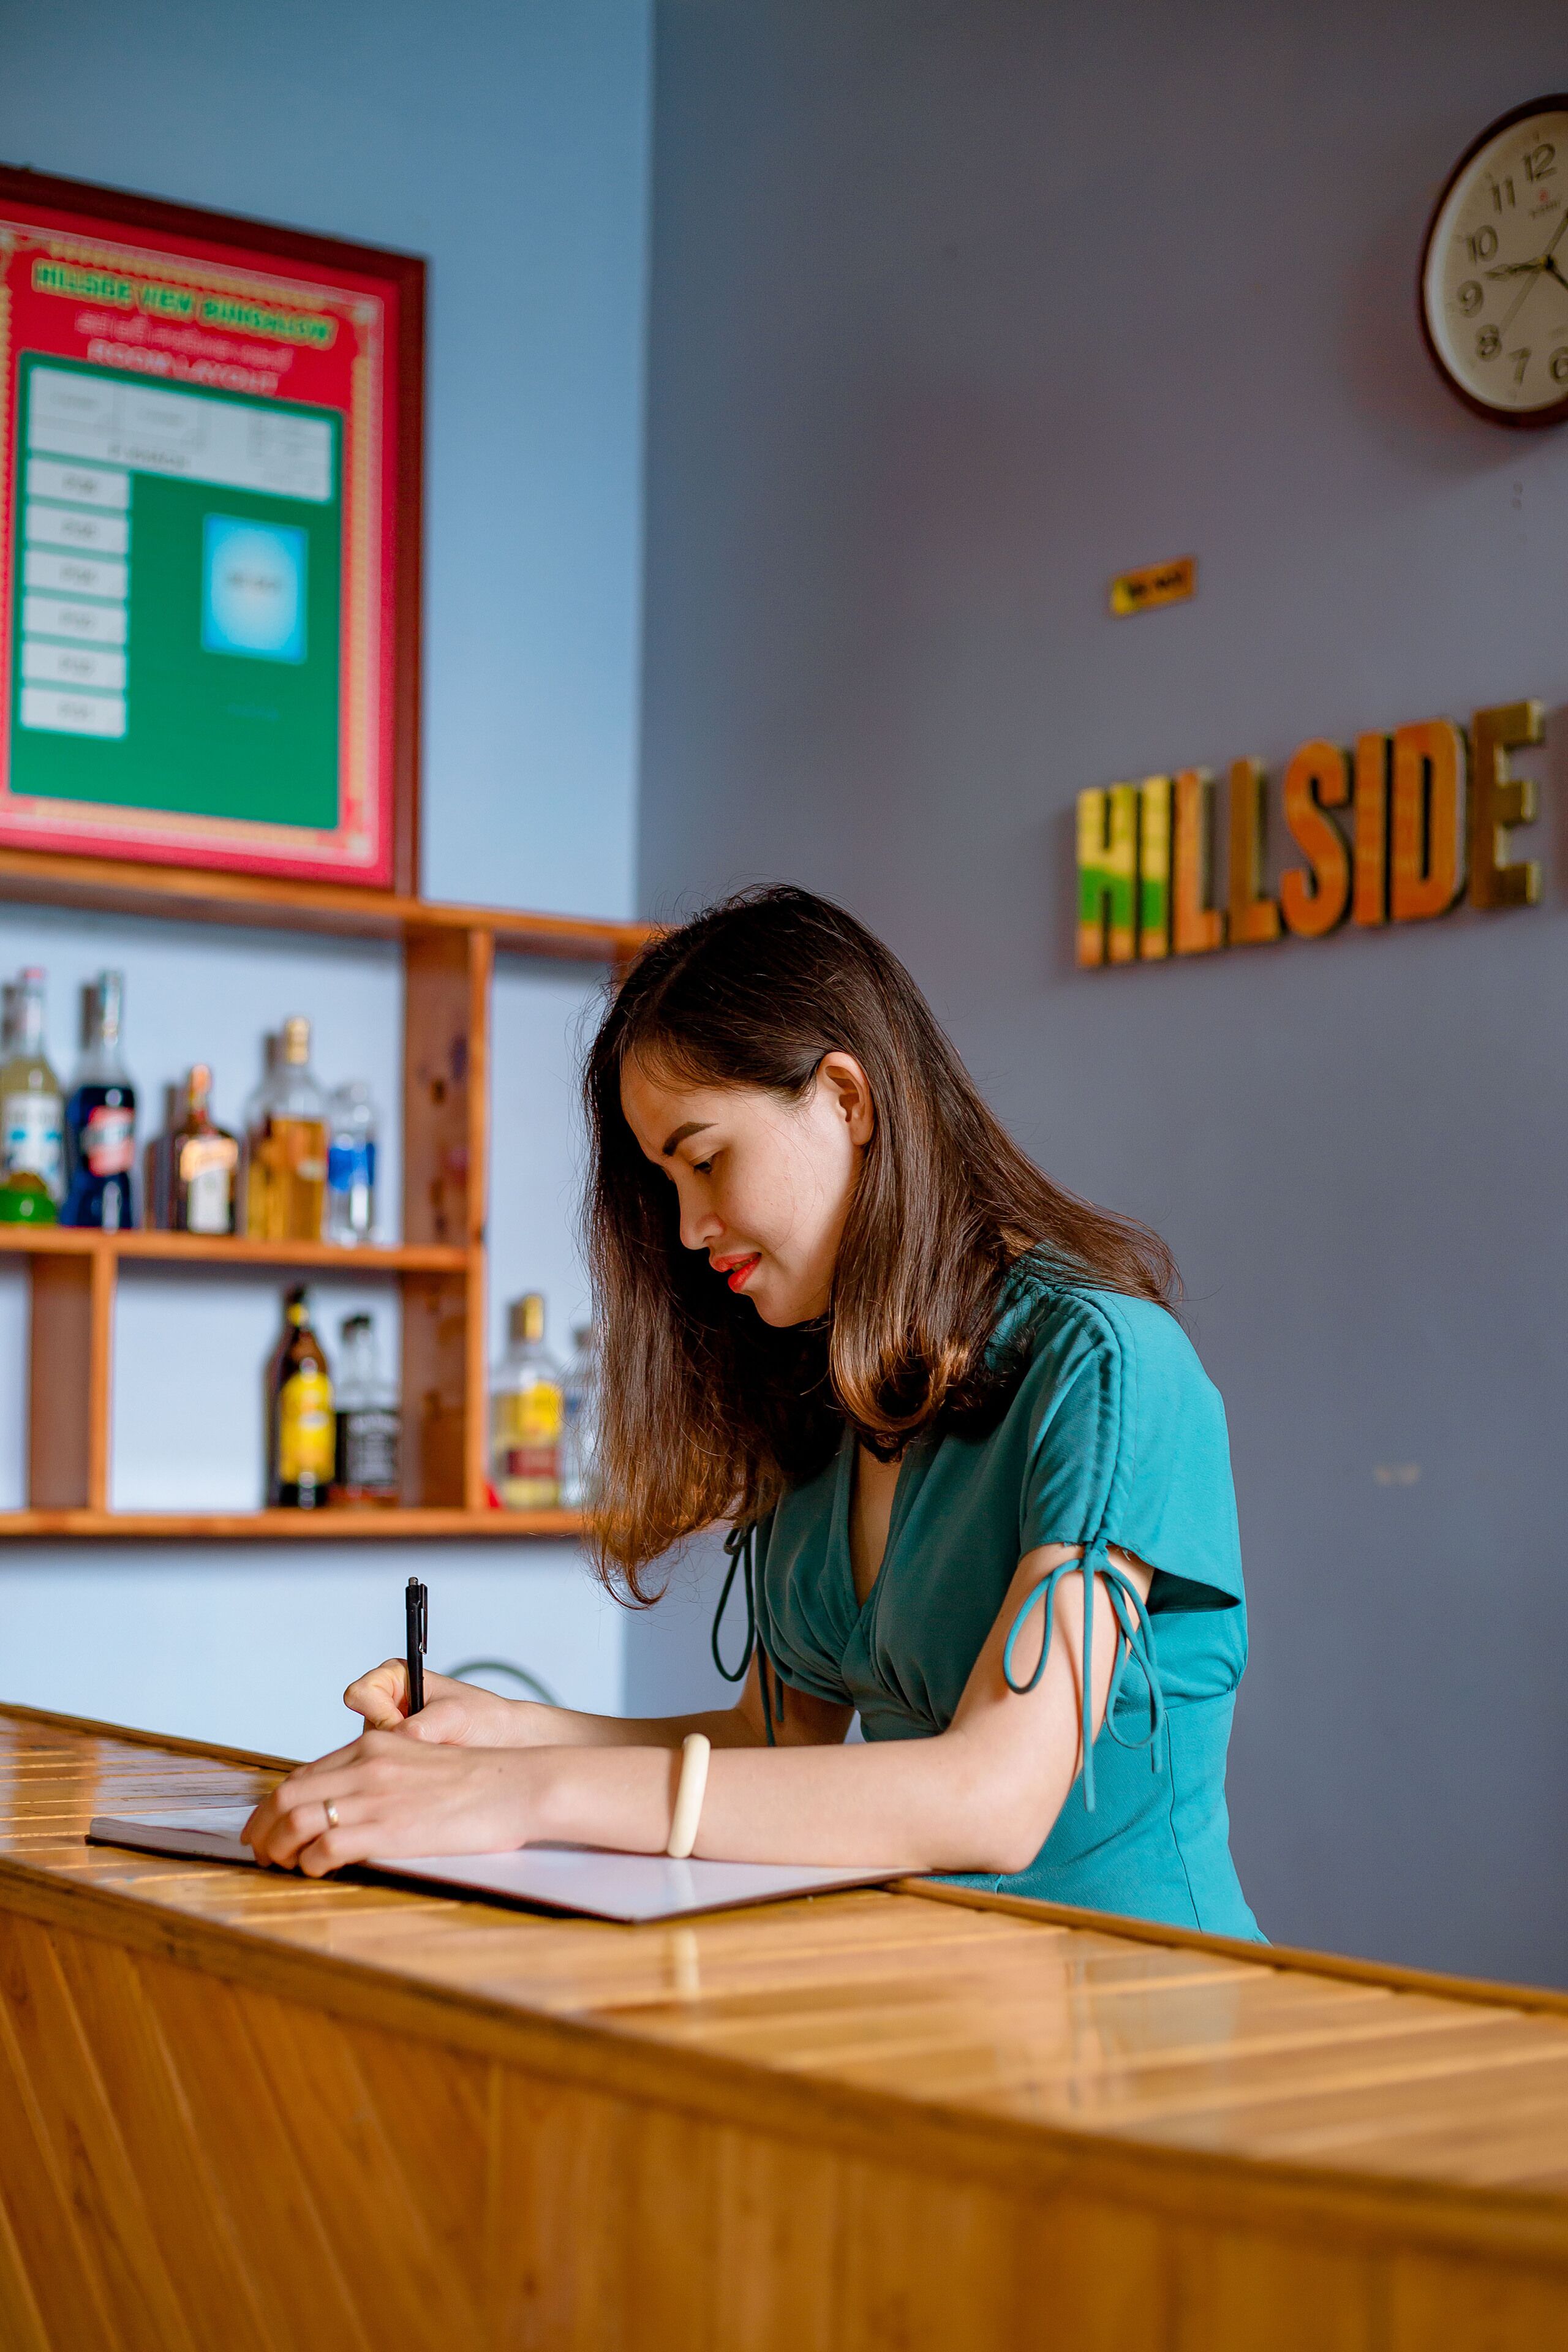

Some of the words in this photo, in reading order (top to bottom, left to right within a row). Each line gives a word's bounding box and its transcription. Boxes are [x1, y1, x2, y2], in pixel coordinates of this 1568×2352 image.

[1523, 143, 1557, 182] 12
[1491, 176, 1515, 216] 11
[1466, 224, 1498, 263] 10
[1457, 279, 1484, 318] 9
[1476, 324, 1502, 363] 8
[1509, 348, 1531, 385] 7
[1077, 698, 1542, 968] HILLSIDE
